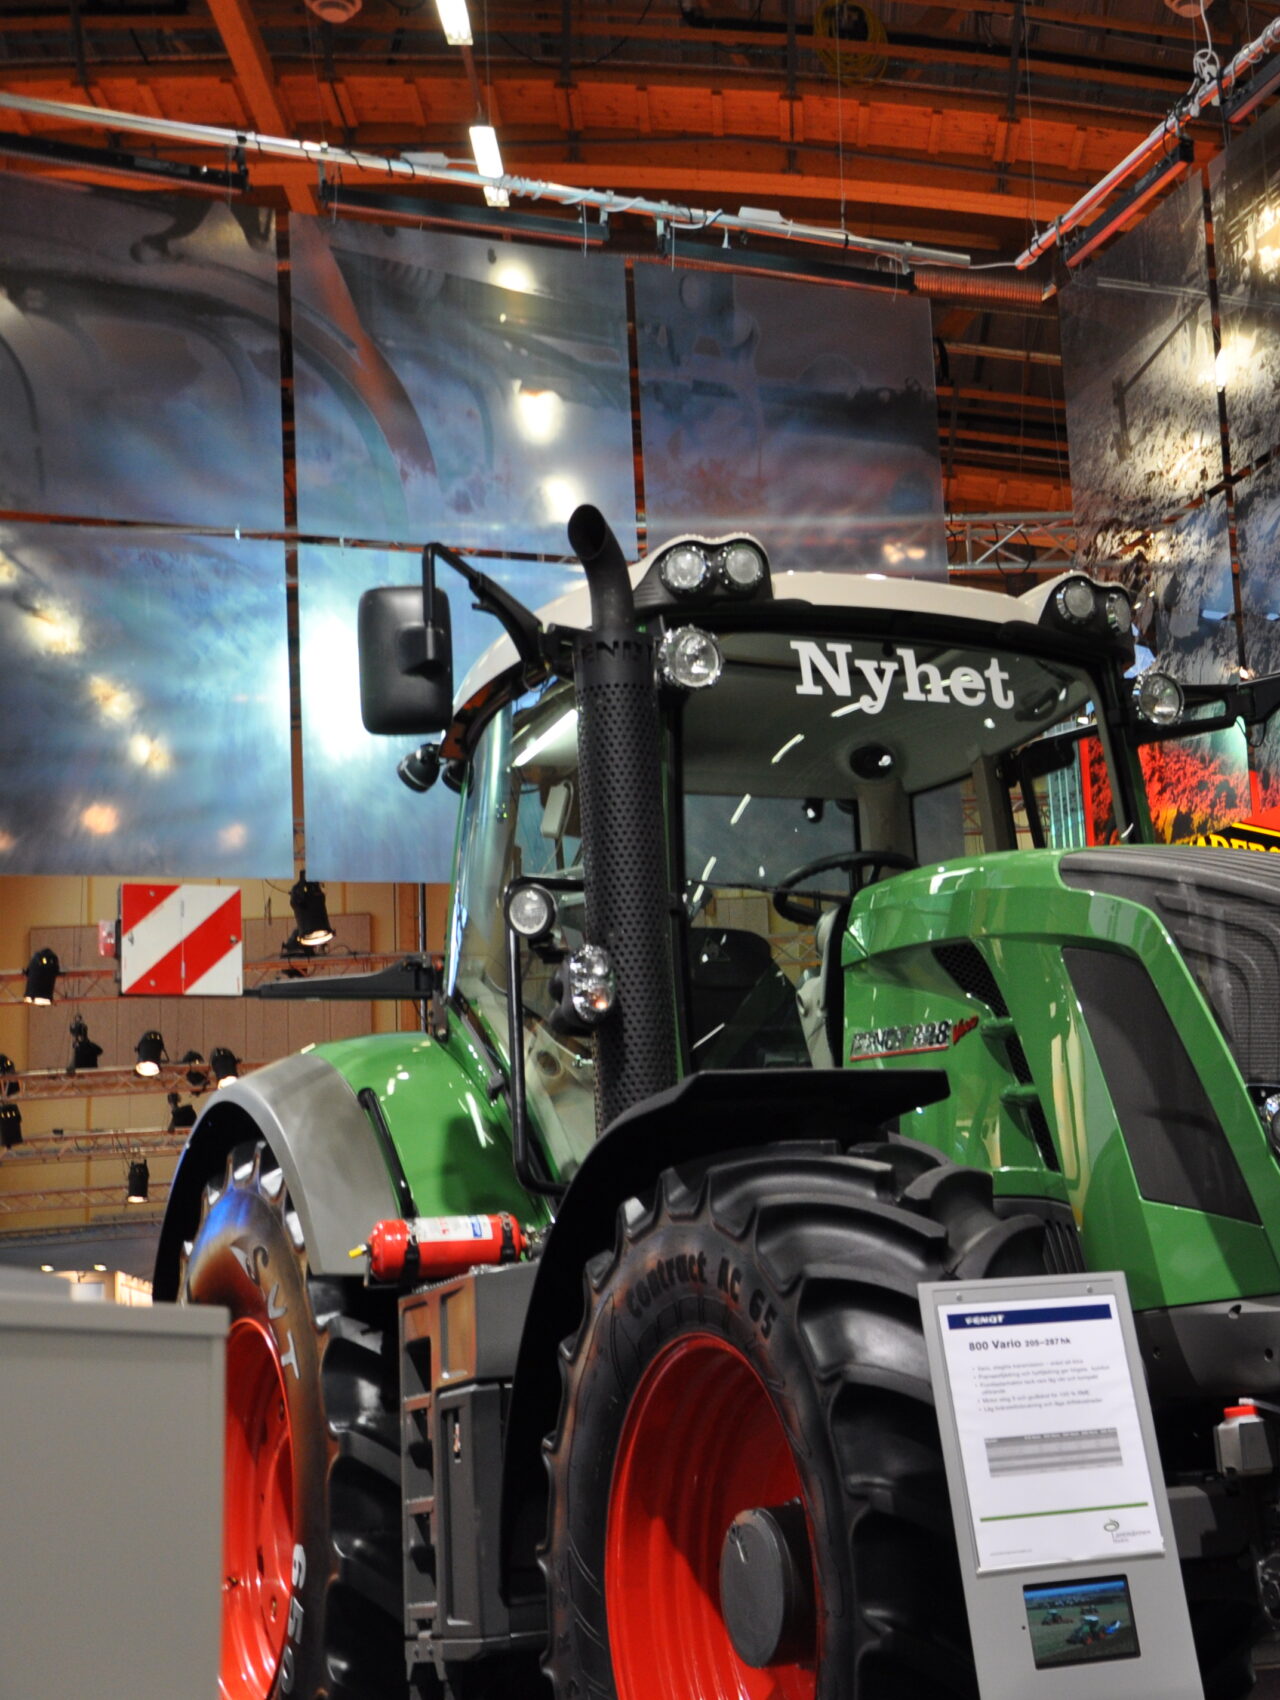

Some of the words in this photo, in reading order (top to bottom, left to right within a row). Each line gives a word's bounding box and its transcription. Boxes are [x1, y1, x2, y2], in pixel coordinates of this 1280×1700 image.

[789, 640, 1015, 715] Nyhet
[964, 1314, 1005, 1326] FENDT
[969, 1341, 989, 1352] 800
[991, 1339, 1022, 1351] Vario
[1060, 1336, 1071, 1345] hk
